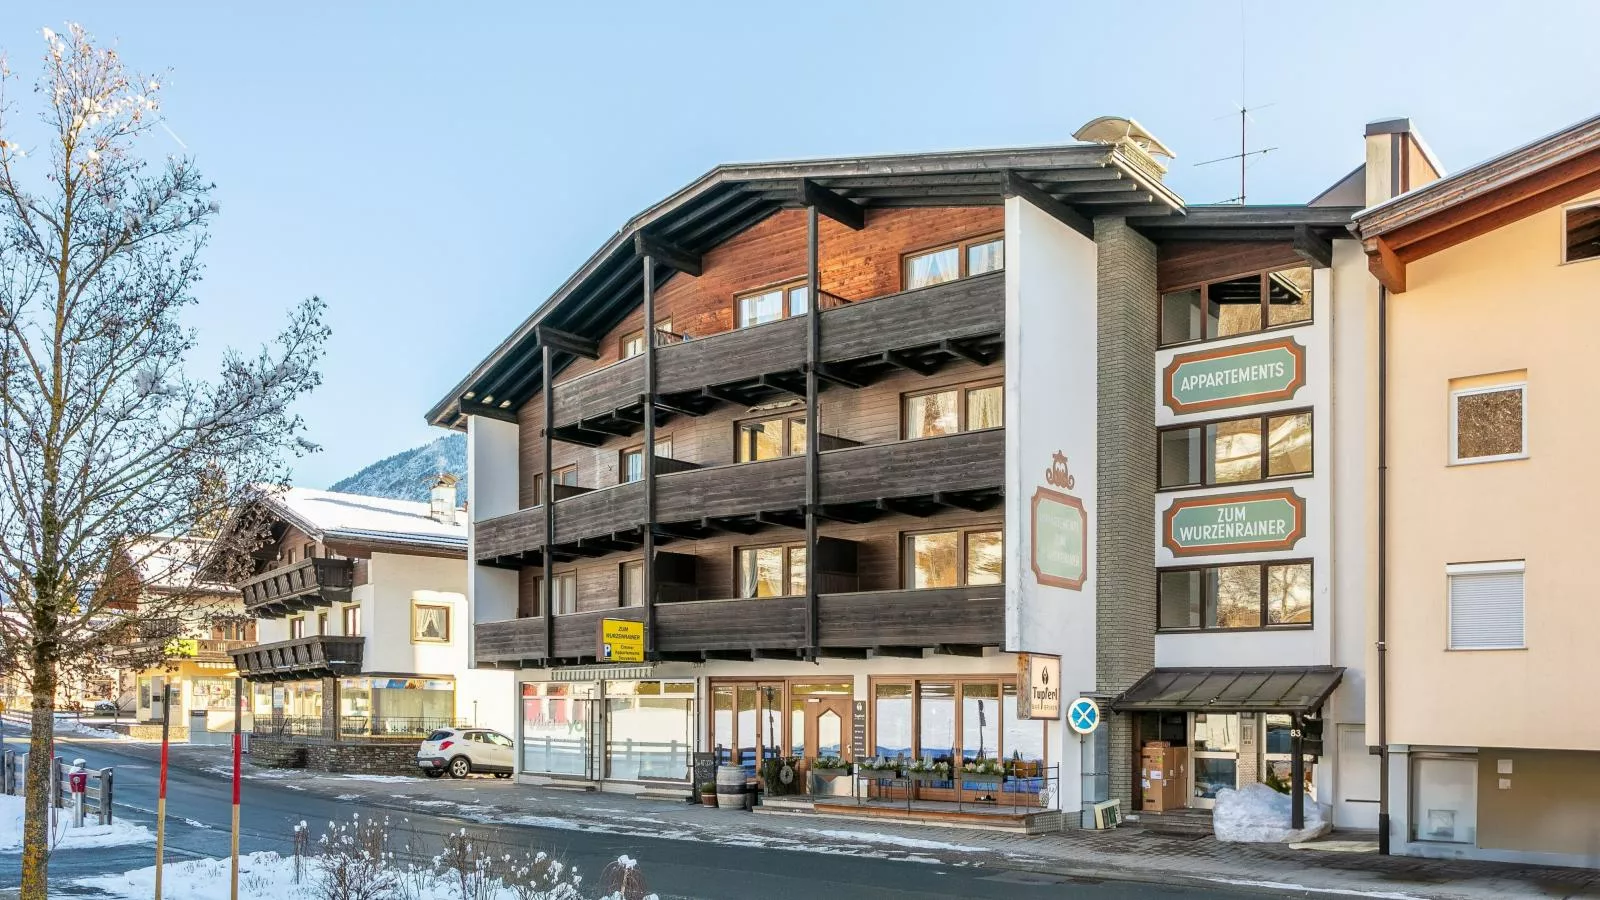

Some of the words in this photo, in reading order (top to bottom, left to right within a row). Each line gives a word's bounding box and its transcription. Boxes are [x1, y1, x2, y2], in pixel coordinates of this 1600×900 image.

[1180, 361, 1284, 392] APPARTEMENTS
[1217, 506, 1246, 523] ZUM
[1179, 519, 1286, 541] WURZENRAINER
[604, 645, 611, 657] P
[1032, 686, 1058, 709] Tupferl
[1290, 729, 1301, 737] 83
